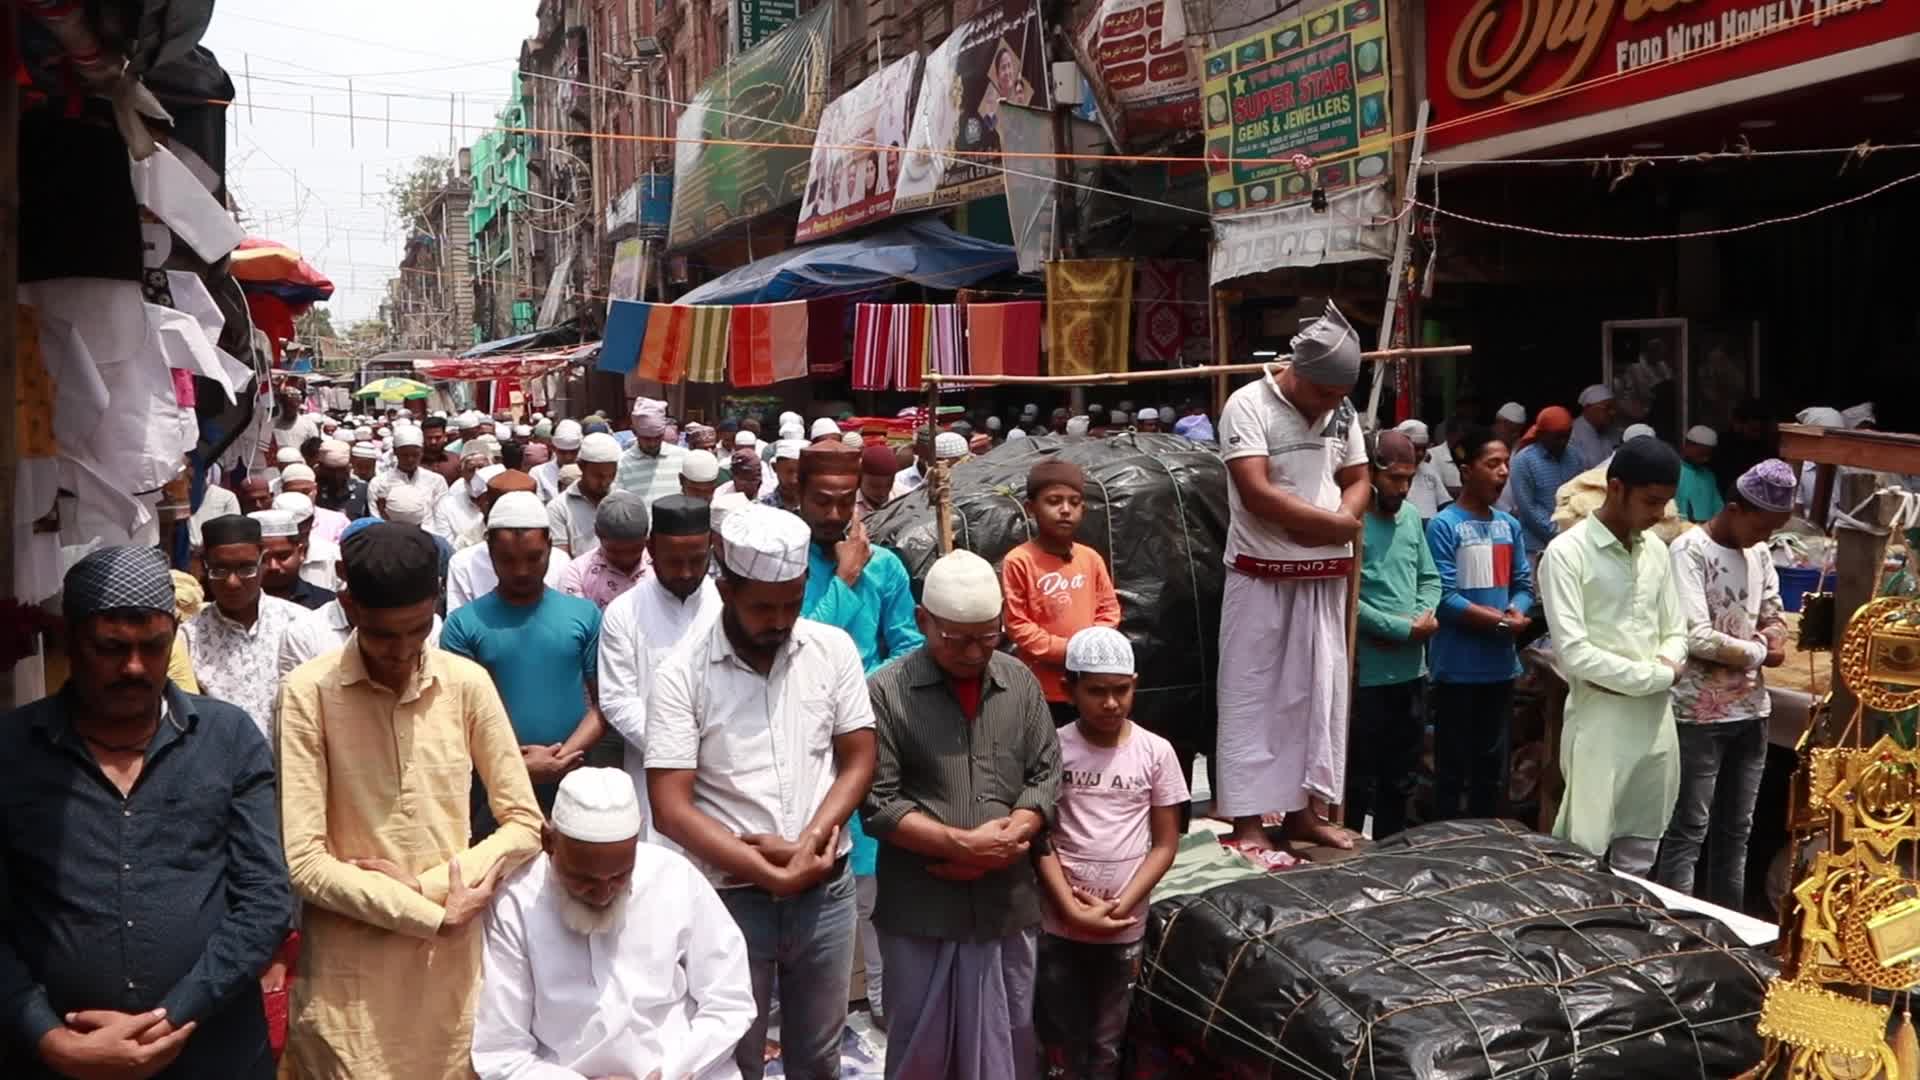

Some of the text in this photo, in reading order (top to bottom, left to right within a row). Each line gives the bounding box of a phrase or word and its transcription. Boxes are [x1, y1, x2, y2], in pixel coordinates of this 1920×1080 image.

[741, 0, 753, 48] UEST
[1233, 81, 1296, 124] SUPER
[1299, 62, 1351, 105] STAR
[1239, 120, 1270, 142] GEMS
[1272, 116, 1280, 134] &
[1283, 94, 1351, 130] JEWELLERS
